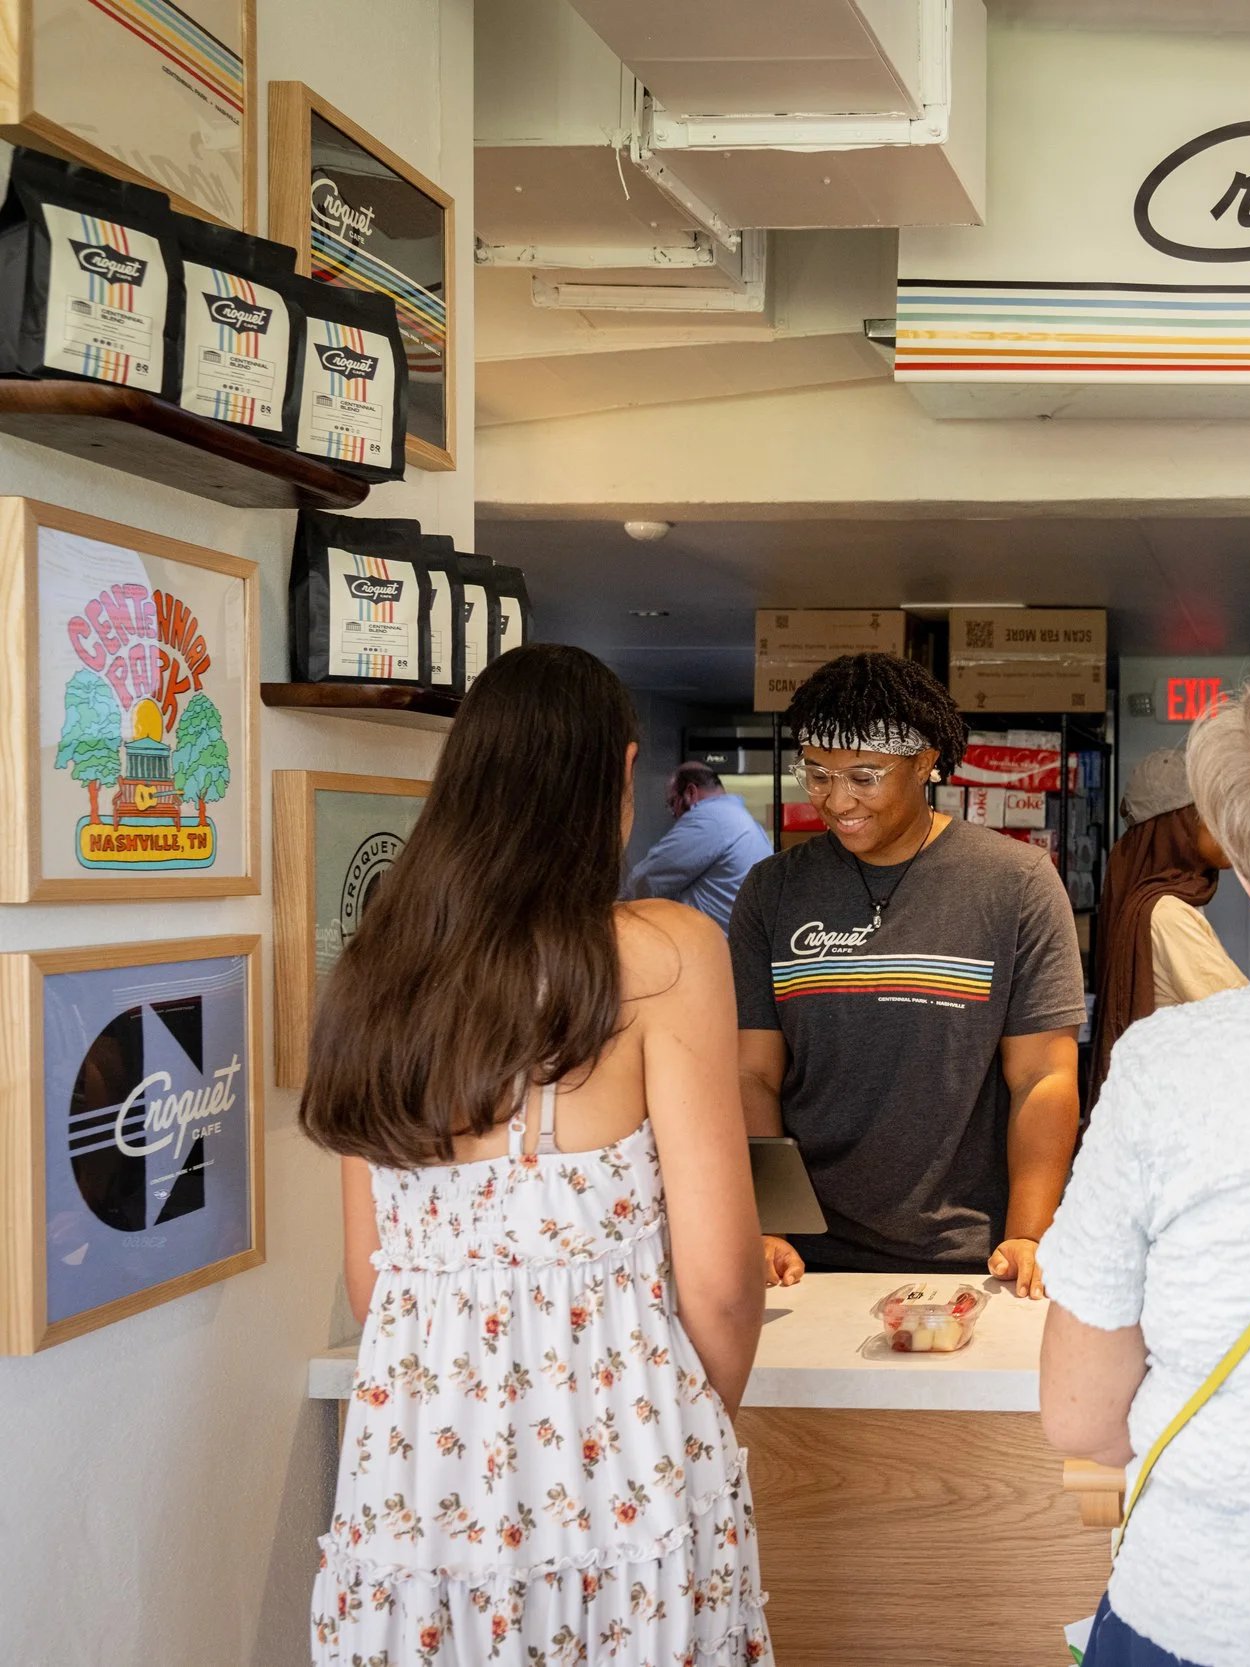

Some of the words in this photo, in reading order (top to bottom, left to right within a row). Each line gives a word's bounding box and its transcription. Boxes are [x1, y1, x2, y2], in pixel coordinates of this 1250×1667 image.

[311, 178, 375, 238] Croquet
[349, 231, 365, 244] CAFE
[79, 248, 142, 278] Croquet
[101, 308, 144, 324] CENTENNIAL
[101, 314, 124, 324] BLEND
[212, 301, 266, 328] Croquet
[230, 357, 268, 369] CENTENNIAL
[230, 361, 251, 370] BLEND
[322, 350, 373, 374] Croquet
[340, 400, 376, 412] CENTENNIAL
[351, 580, 399, 600] Croquet
[68, 584, 210, 692] CENTENNIAL
[1064, 629, 1092, 642] SCAN
[107, 643, 190, 733] PARK
[769, 680, 796, 692] SCAN
[1168, 678, 1221, 720] EXIT
[1008, 794, 1043, 810] Coke
[90, 833, 185, 853] NASHVILLE,
[187, 833, 207, 849] TN
[346, 841, 397, 917] CROQUET
[790, 921, 874, 958] Croquet
[936, 1001, 966, 1009] NASHVILLE
[114, 1054, 241, 1159] Croquet
[192, 1122, 222, 1140] CAFE
